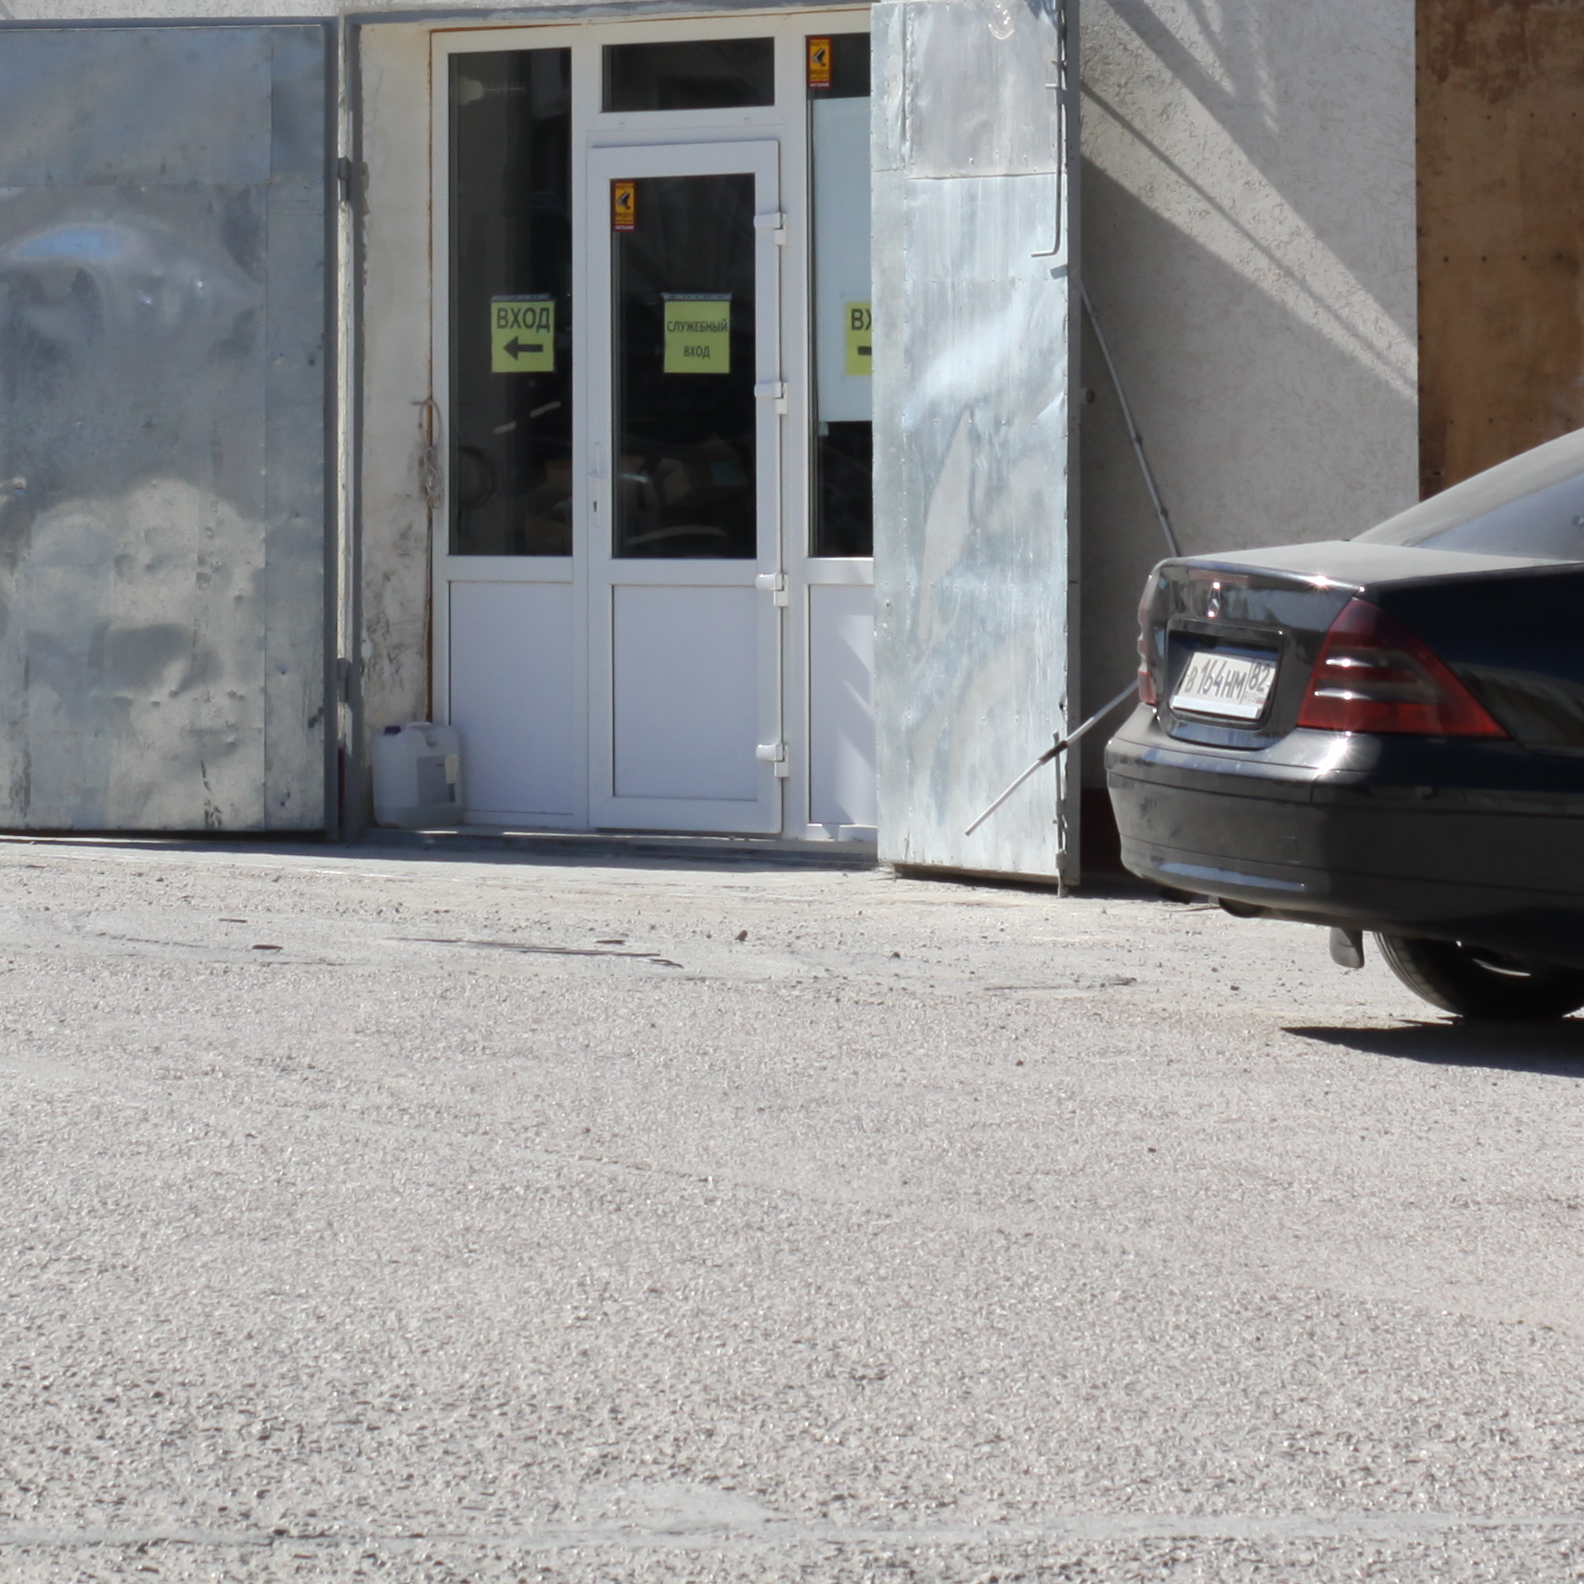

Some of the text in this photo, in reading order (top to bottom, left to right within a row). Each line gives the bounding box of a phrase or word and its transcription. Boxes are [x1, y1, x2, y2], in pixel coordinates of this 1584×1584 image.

[496, 307, 551, 333] ВХОД
[667, 318, 728, 333] СЛУЖЕБНЫЙ
[684, 346, 710, 358] ВХОД
[1248, 661, 1271, 692] 82
